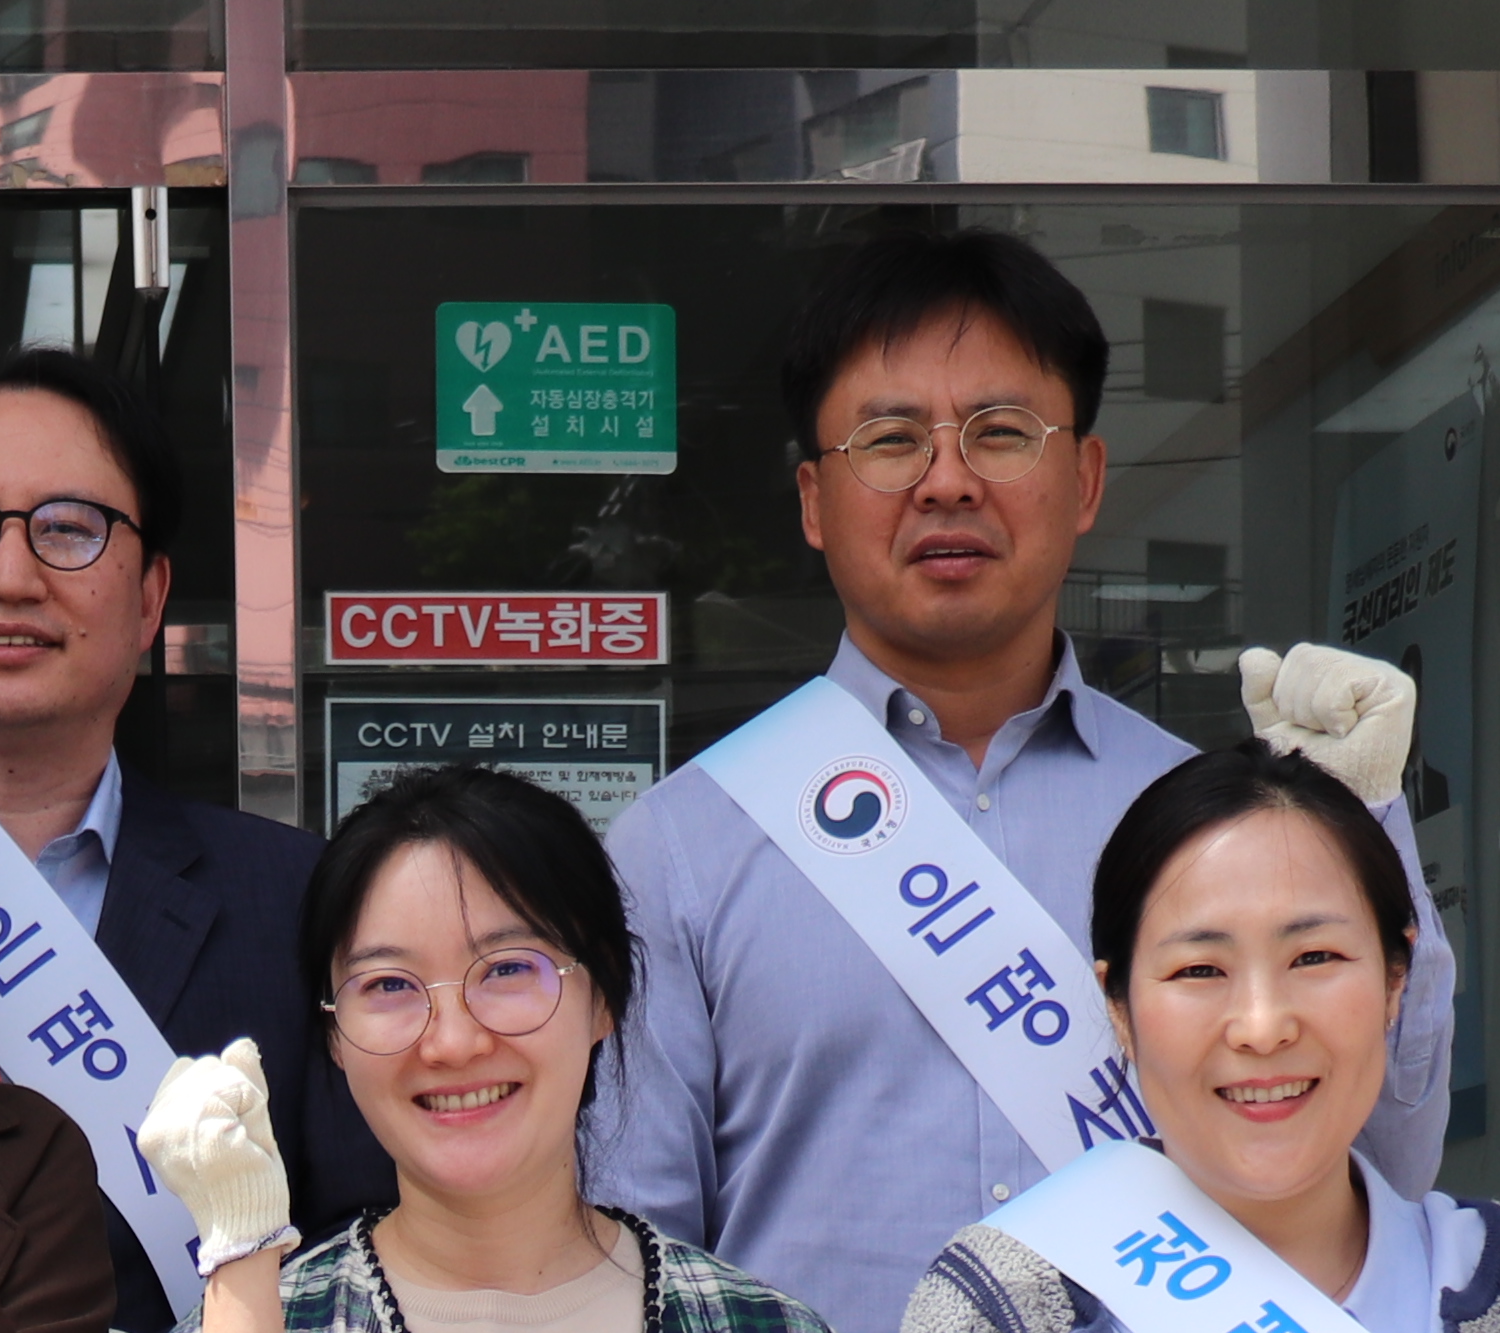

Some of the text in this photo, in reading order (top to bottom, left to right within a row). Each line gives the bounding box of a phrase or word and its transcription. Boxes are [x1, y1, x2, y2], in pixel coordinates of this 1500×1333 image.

[535, 325, 651, 363] AED
[530, 389, 654, 410] 자동심장충격기
[1342, 561, 1422, 646] 국선대리인
[1425, 538, 1458, 598] 제도
[340, 602, 648, 654] CCTV녹화중
[357, 721, 628, 749] CCTV 설치 안내문
[899, 863, 1163, 1151] 은평세
